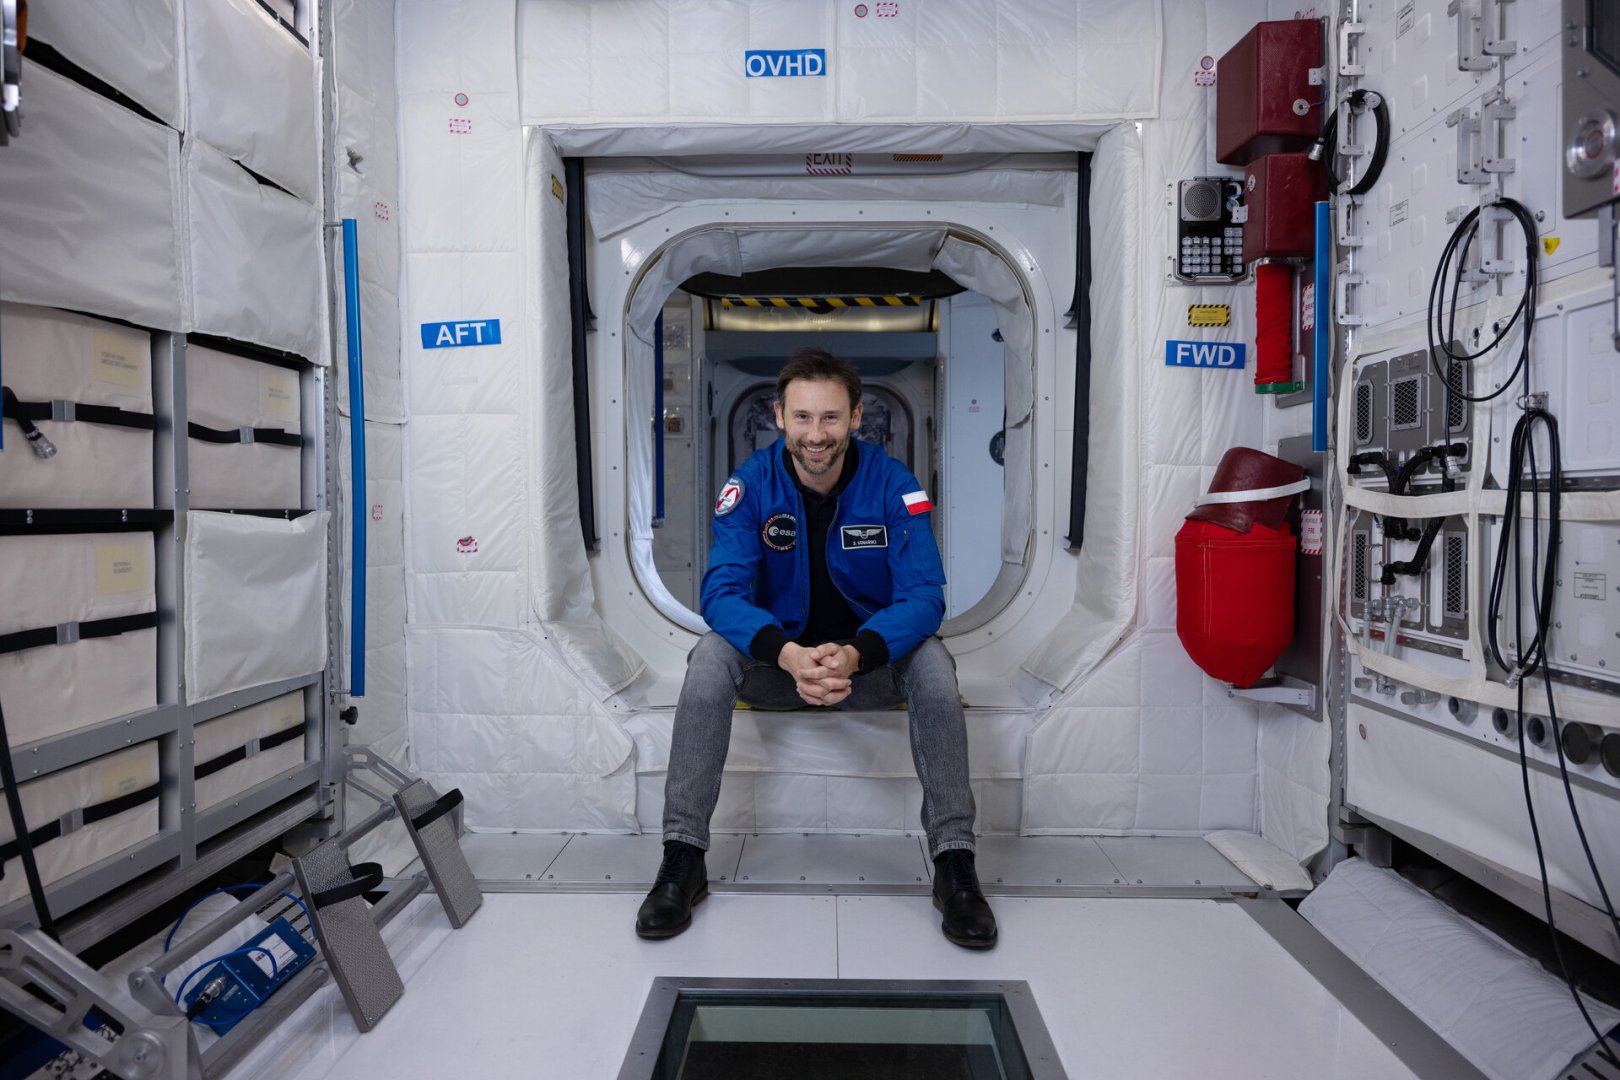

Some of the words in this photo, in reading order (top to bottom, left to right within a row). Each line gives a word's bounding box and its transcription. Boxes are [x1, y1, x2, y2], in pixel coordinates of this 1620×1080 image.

[746, 54, 823, 77] OVHD
[435, 322, 487, 346] AFT
[1176, 343, 1236, 366] FWD
